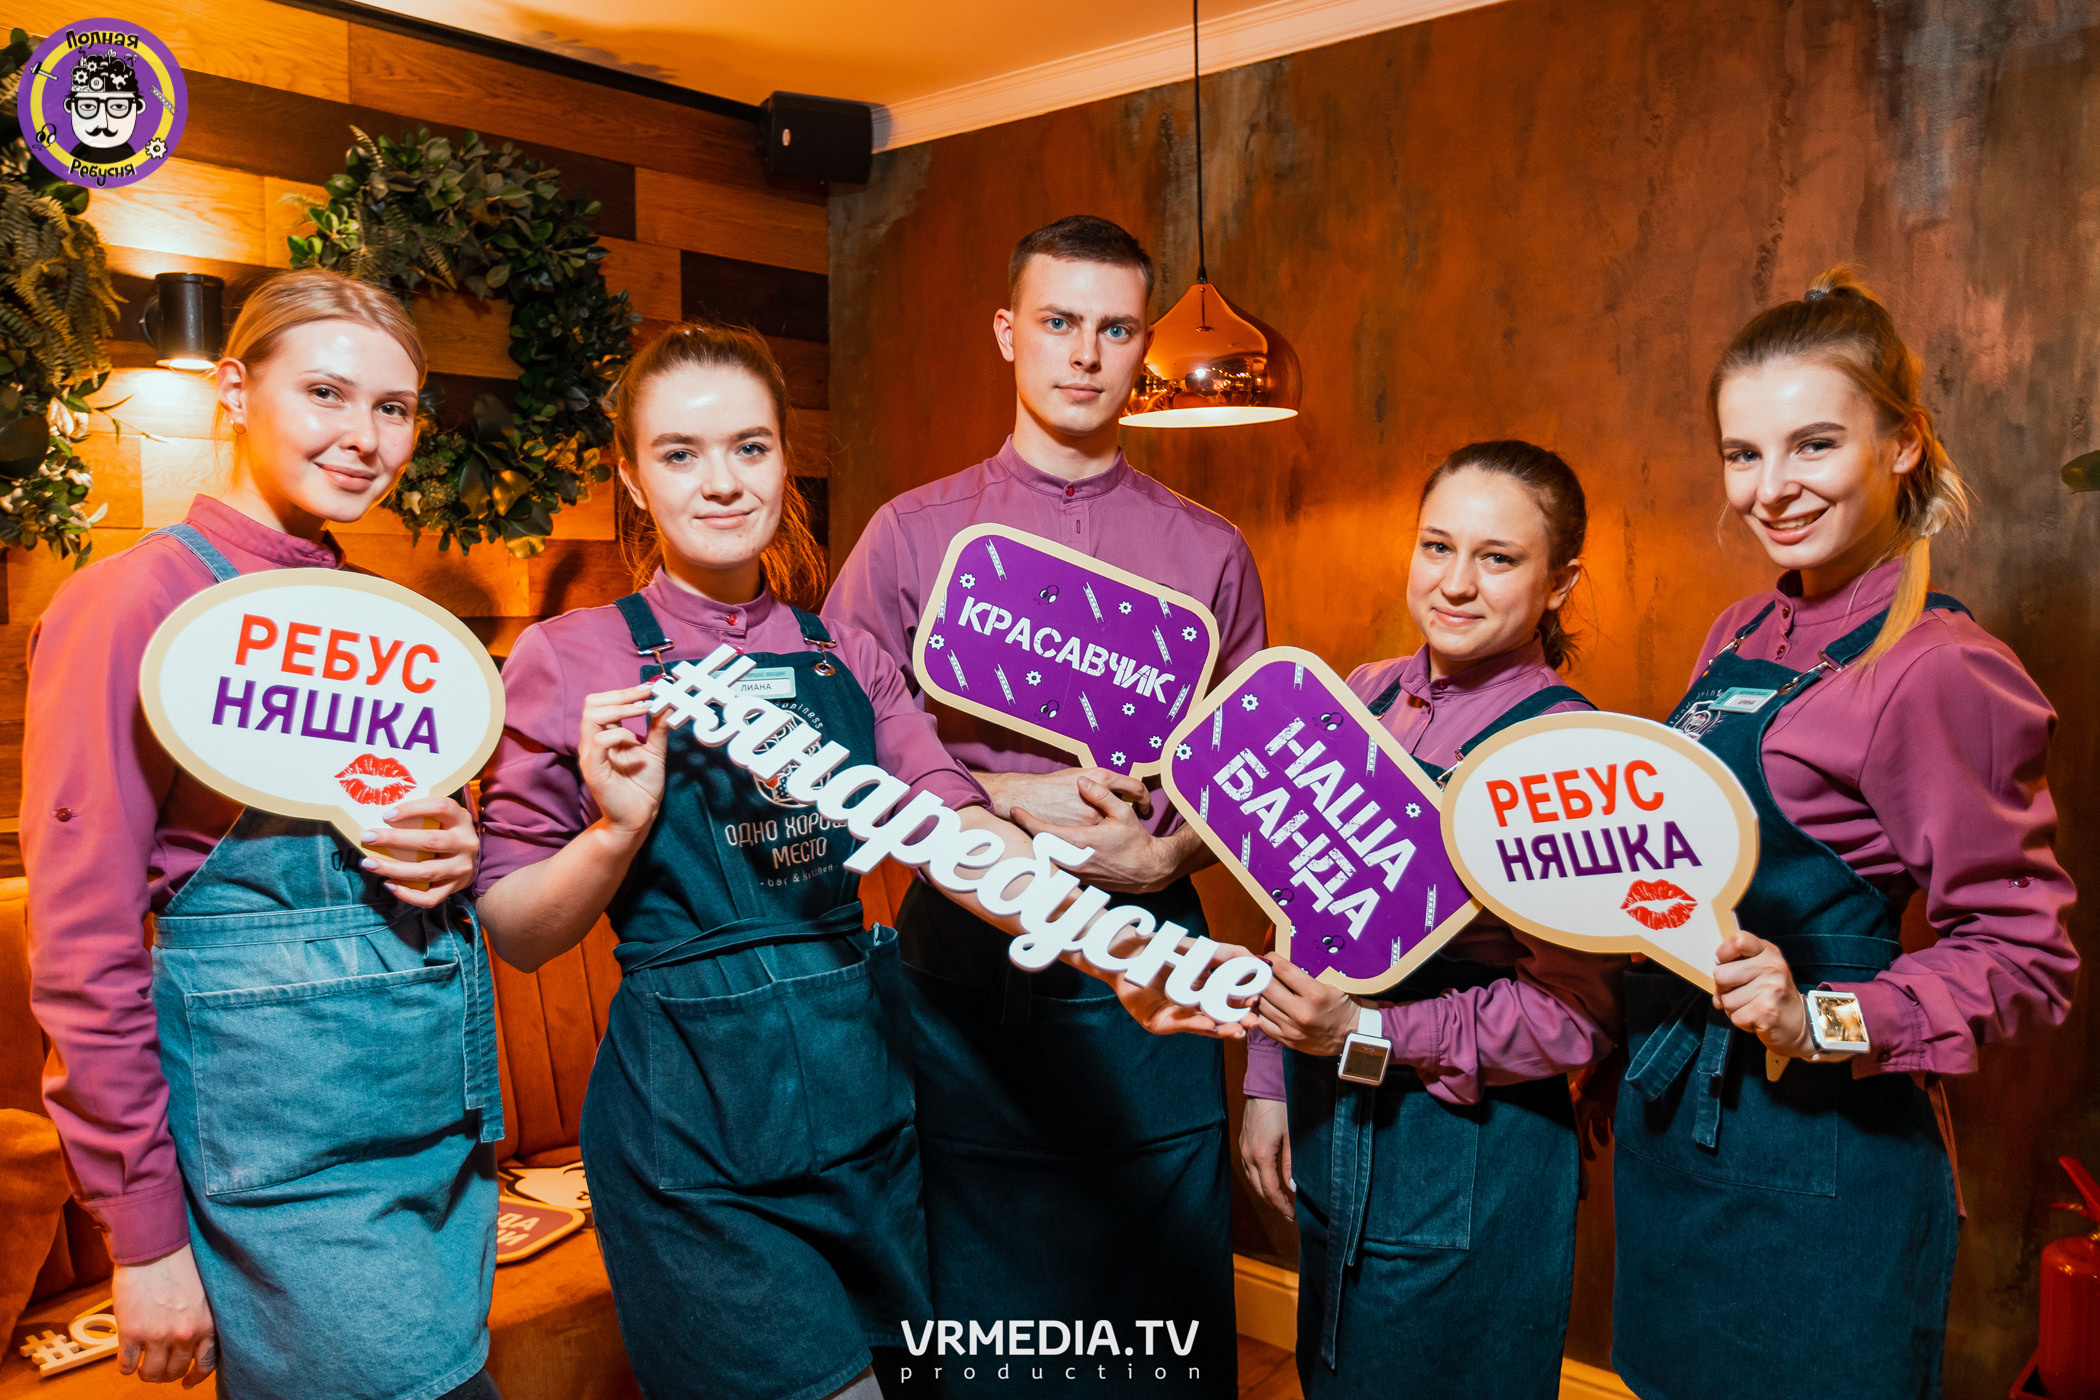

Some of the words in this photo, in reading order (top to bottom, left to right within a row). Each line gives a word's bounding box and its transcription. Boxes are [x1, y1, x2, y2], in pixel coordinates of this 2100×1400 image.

[234, 613, 441, 694] РЕБУС
[957, 595, 1176, 704] КРАСАВЧИК
[211, 675, 440, 755] НЯШКА
[740, 682, 772, 692] ЛИАНА
[1264, 716, 1417, 893] НАША
[1485, 759, 1665, 828] РЕБУС
[724, 819, 779, 848] ОДНО
[771, 836, 828, 870] МЕСТО
[1212, 747, 1381, 941] БАНДА
[1495, 820, 1703, 883] НЯШКА
